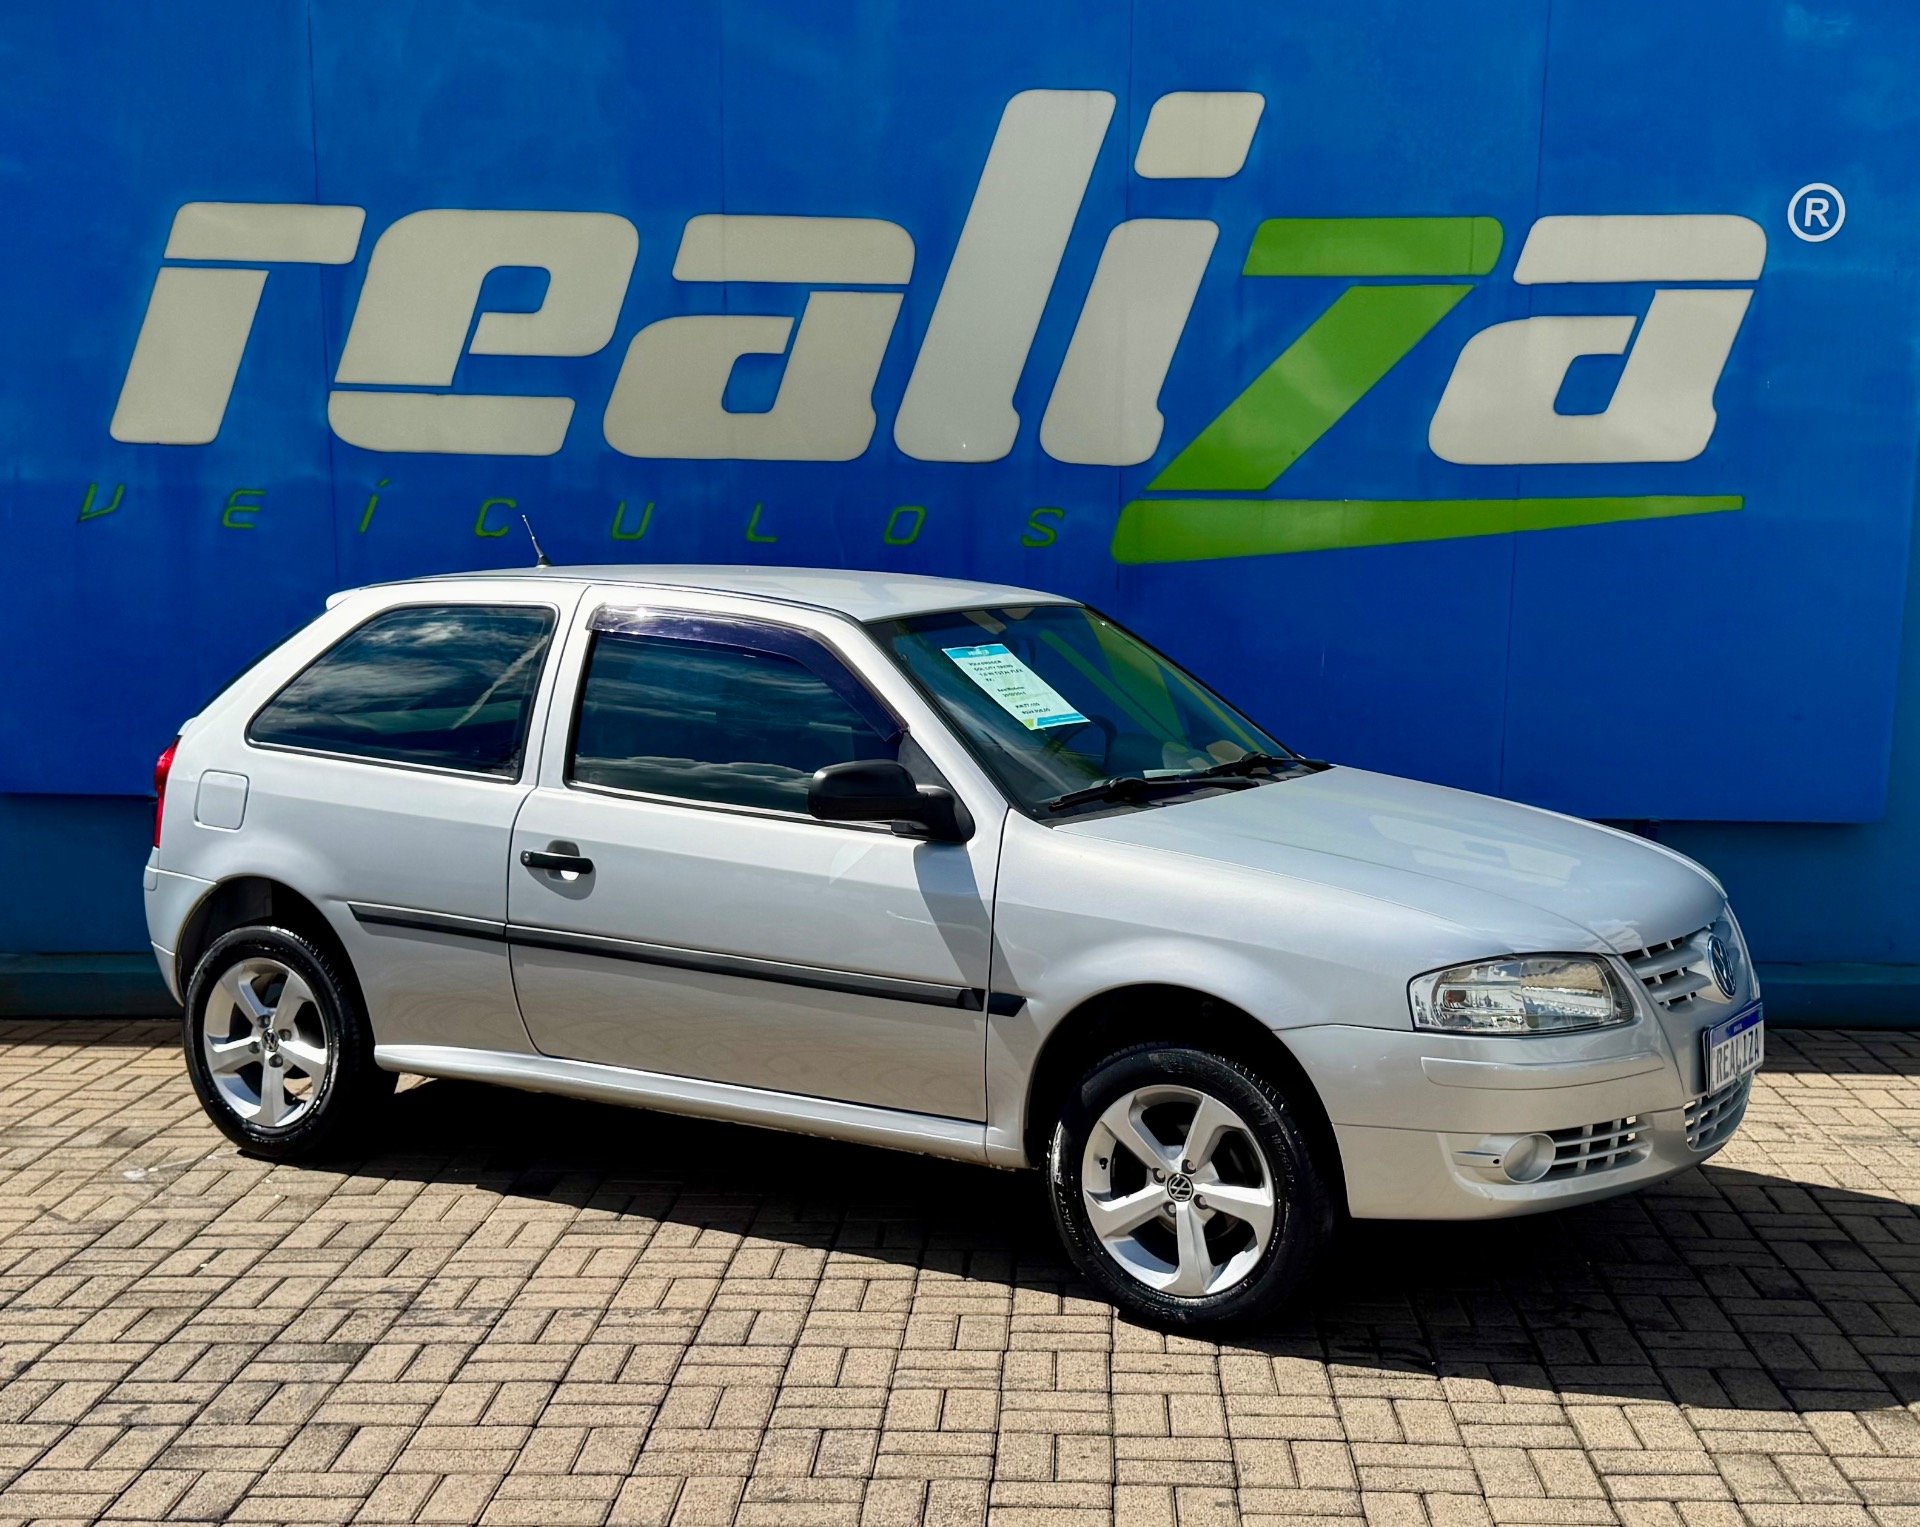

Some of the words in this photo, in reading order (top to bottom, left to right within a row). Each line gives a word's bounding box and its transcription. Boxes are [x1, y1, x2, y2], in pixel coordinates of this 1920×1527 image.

[110, 89, 1767, 564] realiza
[78, 478, 1067, 548] VEÍCULOS
[1716, 1028, 1760, 1083] REALIZA
